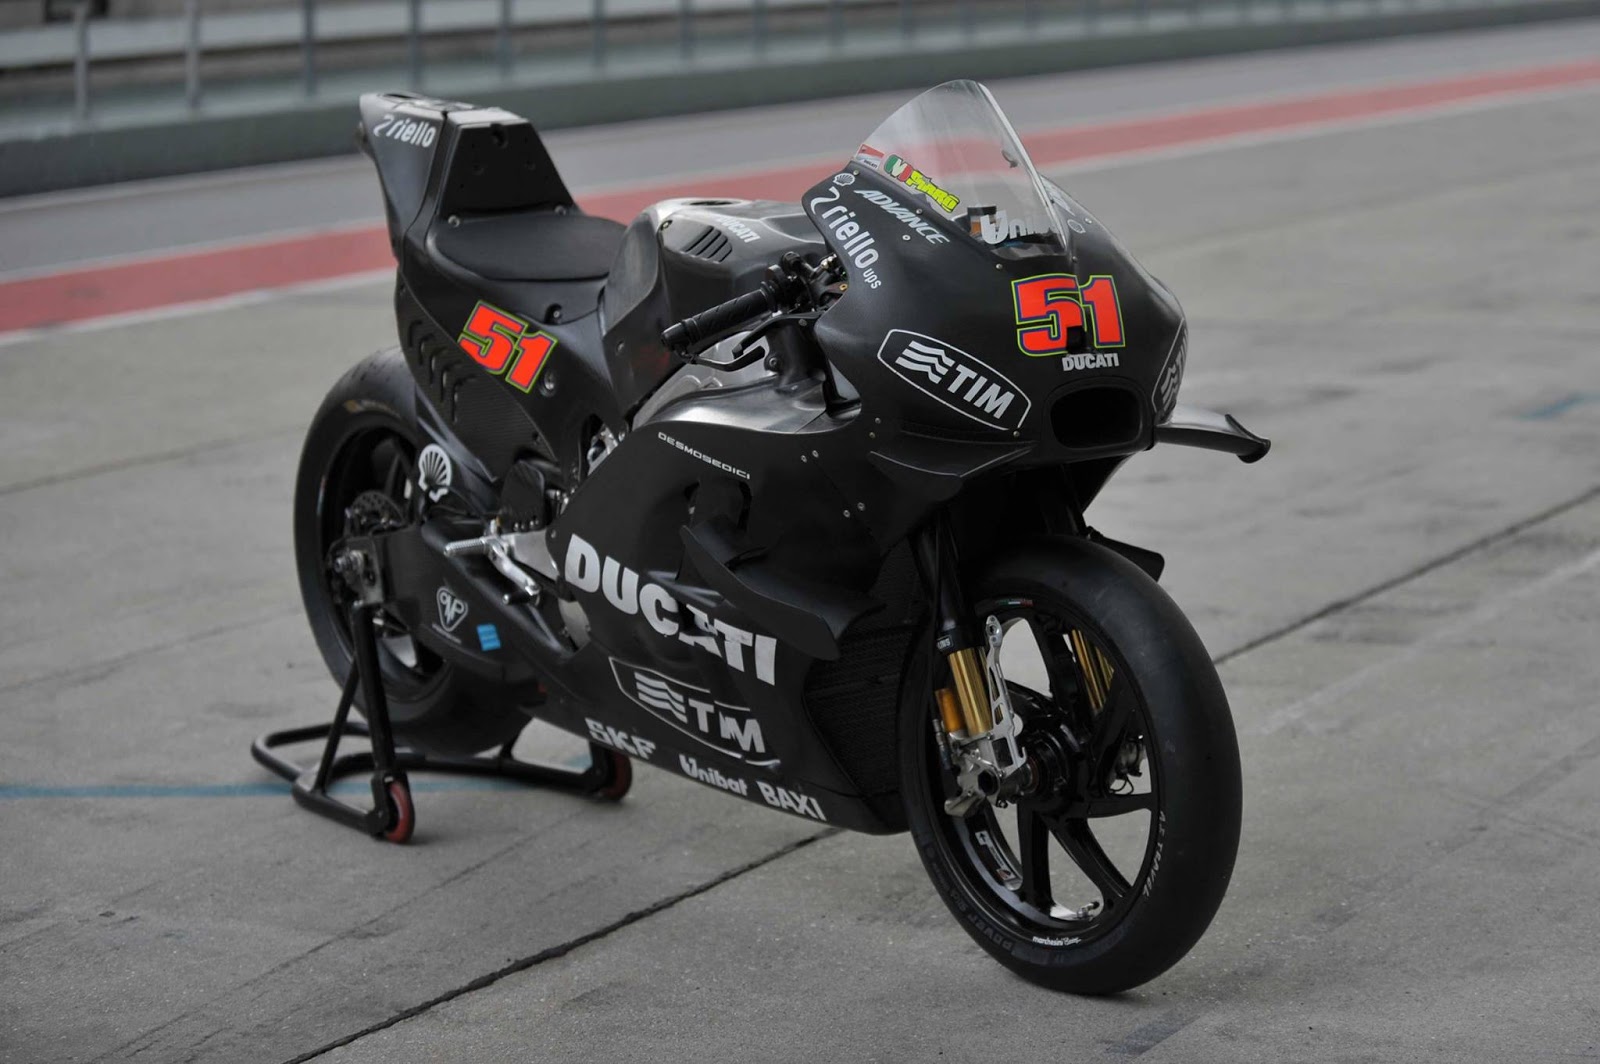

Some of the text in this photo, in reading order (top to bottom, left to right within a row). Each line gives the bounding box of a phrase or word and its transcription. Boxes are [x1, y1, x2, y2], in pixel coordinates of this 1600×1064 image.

[386, 118, 436, 148] riello
[853, 190, 950, 244] ADVANCE
[822, 205, 882, 289] riello ups
[1011, 273, 1125, 357] 51
[457, 299, 558, 394] 51
[1061, 353, 1120, 371] DUCATI
[947, 363, 1015, 420] TIM
[658, 432, 750, 480] DESMOSEDICI
[564, 533, 777, 686] DUCATI
[584, 717, 656, 760] SKF
[678, 753, 827, 822] Unibat BAXI
